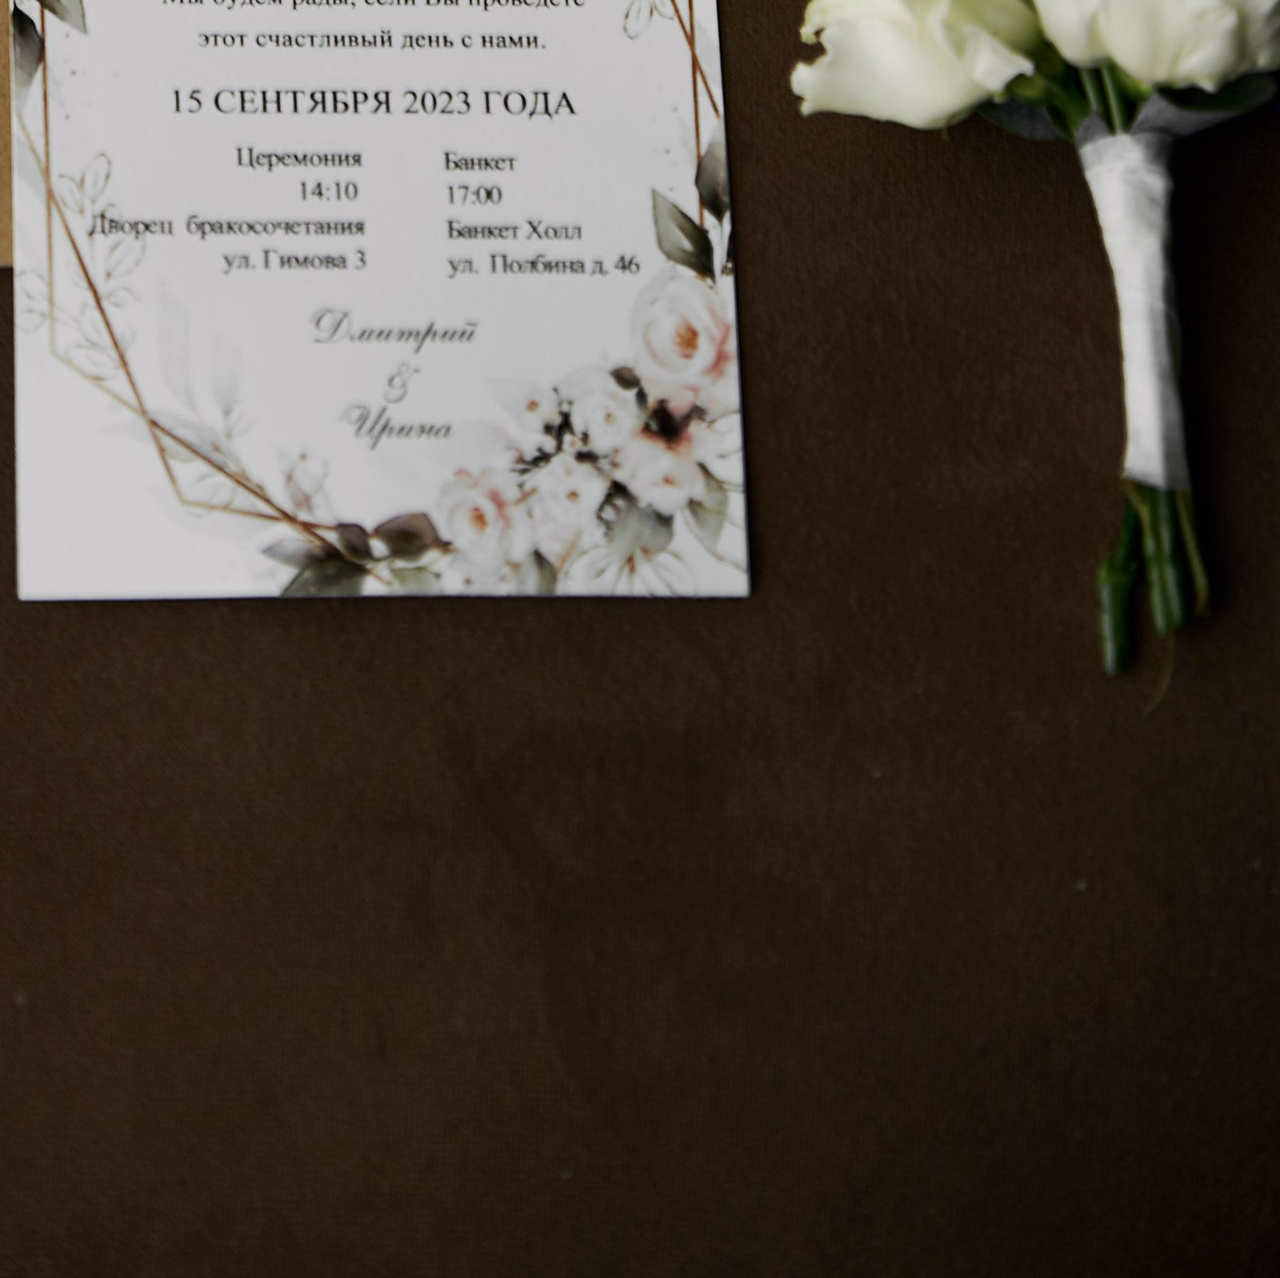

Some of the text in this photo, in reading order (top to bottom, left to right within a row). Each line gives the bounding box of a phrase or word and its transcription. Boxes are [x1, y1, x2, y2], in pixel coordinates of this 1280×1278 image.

[197, 29, 547, 51] этот счастливый день с нами.
[172, 88, 578, 120] 15 СЕНТЯБРЯ 2023 ГОДА
[235, 146, 363, 172] Церемония
[443, 151, 517, 172] Банкет
[299, 180, 360, 201] 14:10
[446, 185, 504, 206] 17:00
[88, 212, 367, 241] Дворец бракосочетания
[446, 219, 584, 241] Банкет Холл
[222, 249, 368, 275] ул. Гимова 3
[446, 253, 642, 279] ул. Полбина д. 46
[310, 307, 479, 355] Дмитрий
[340, 403, 453, 451] Ирина
